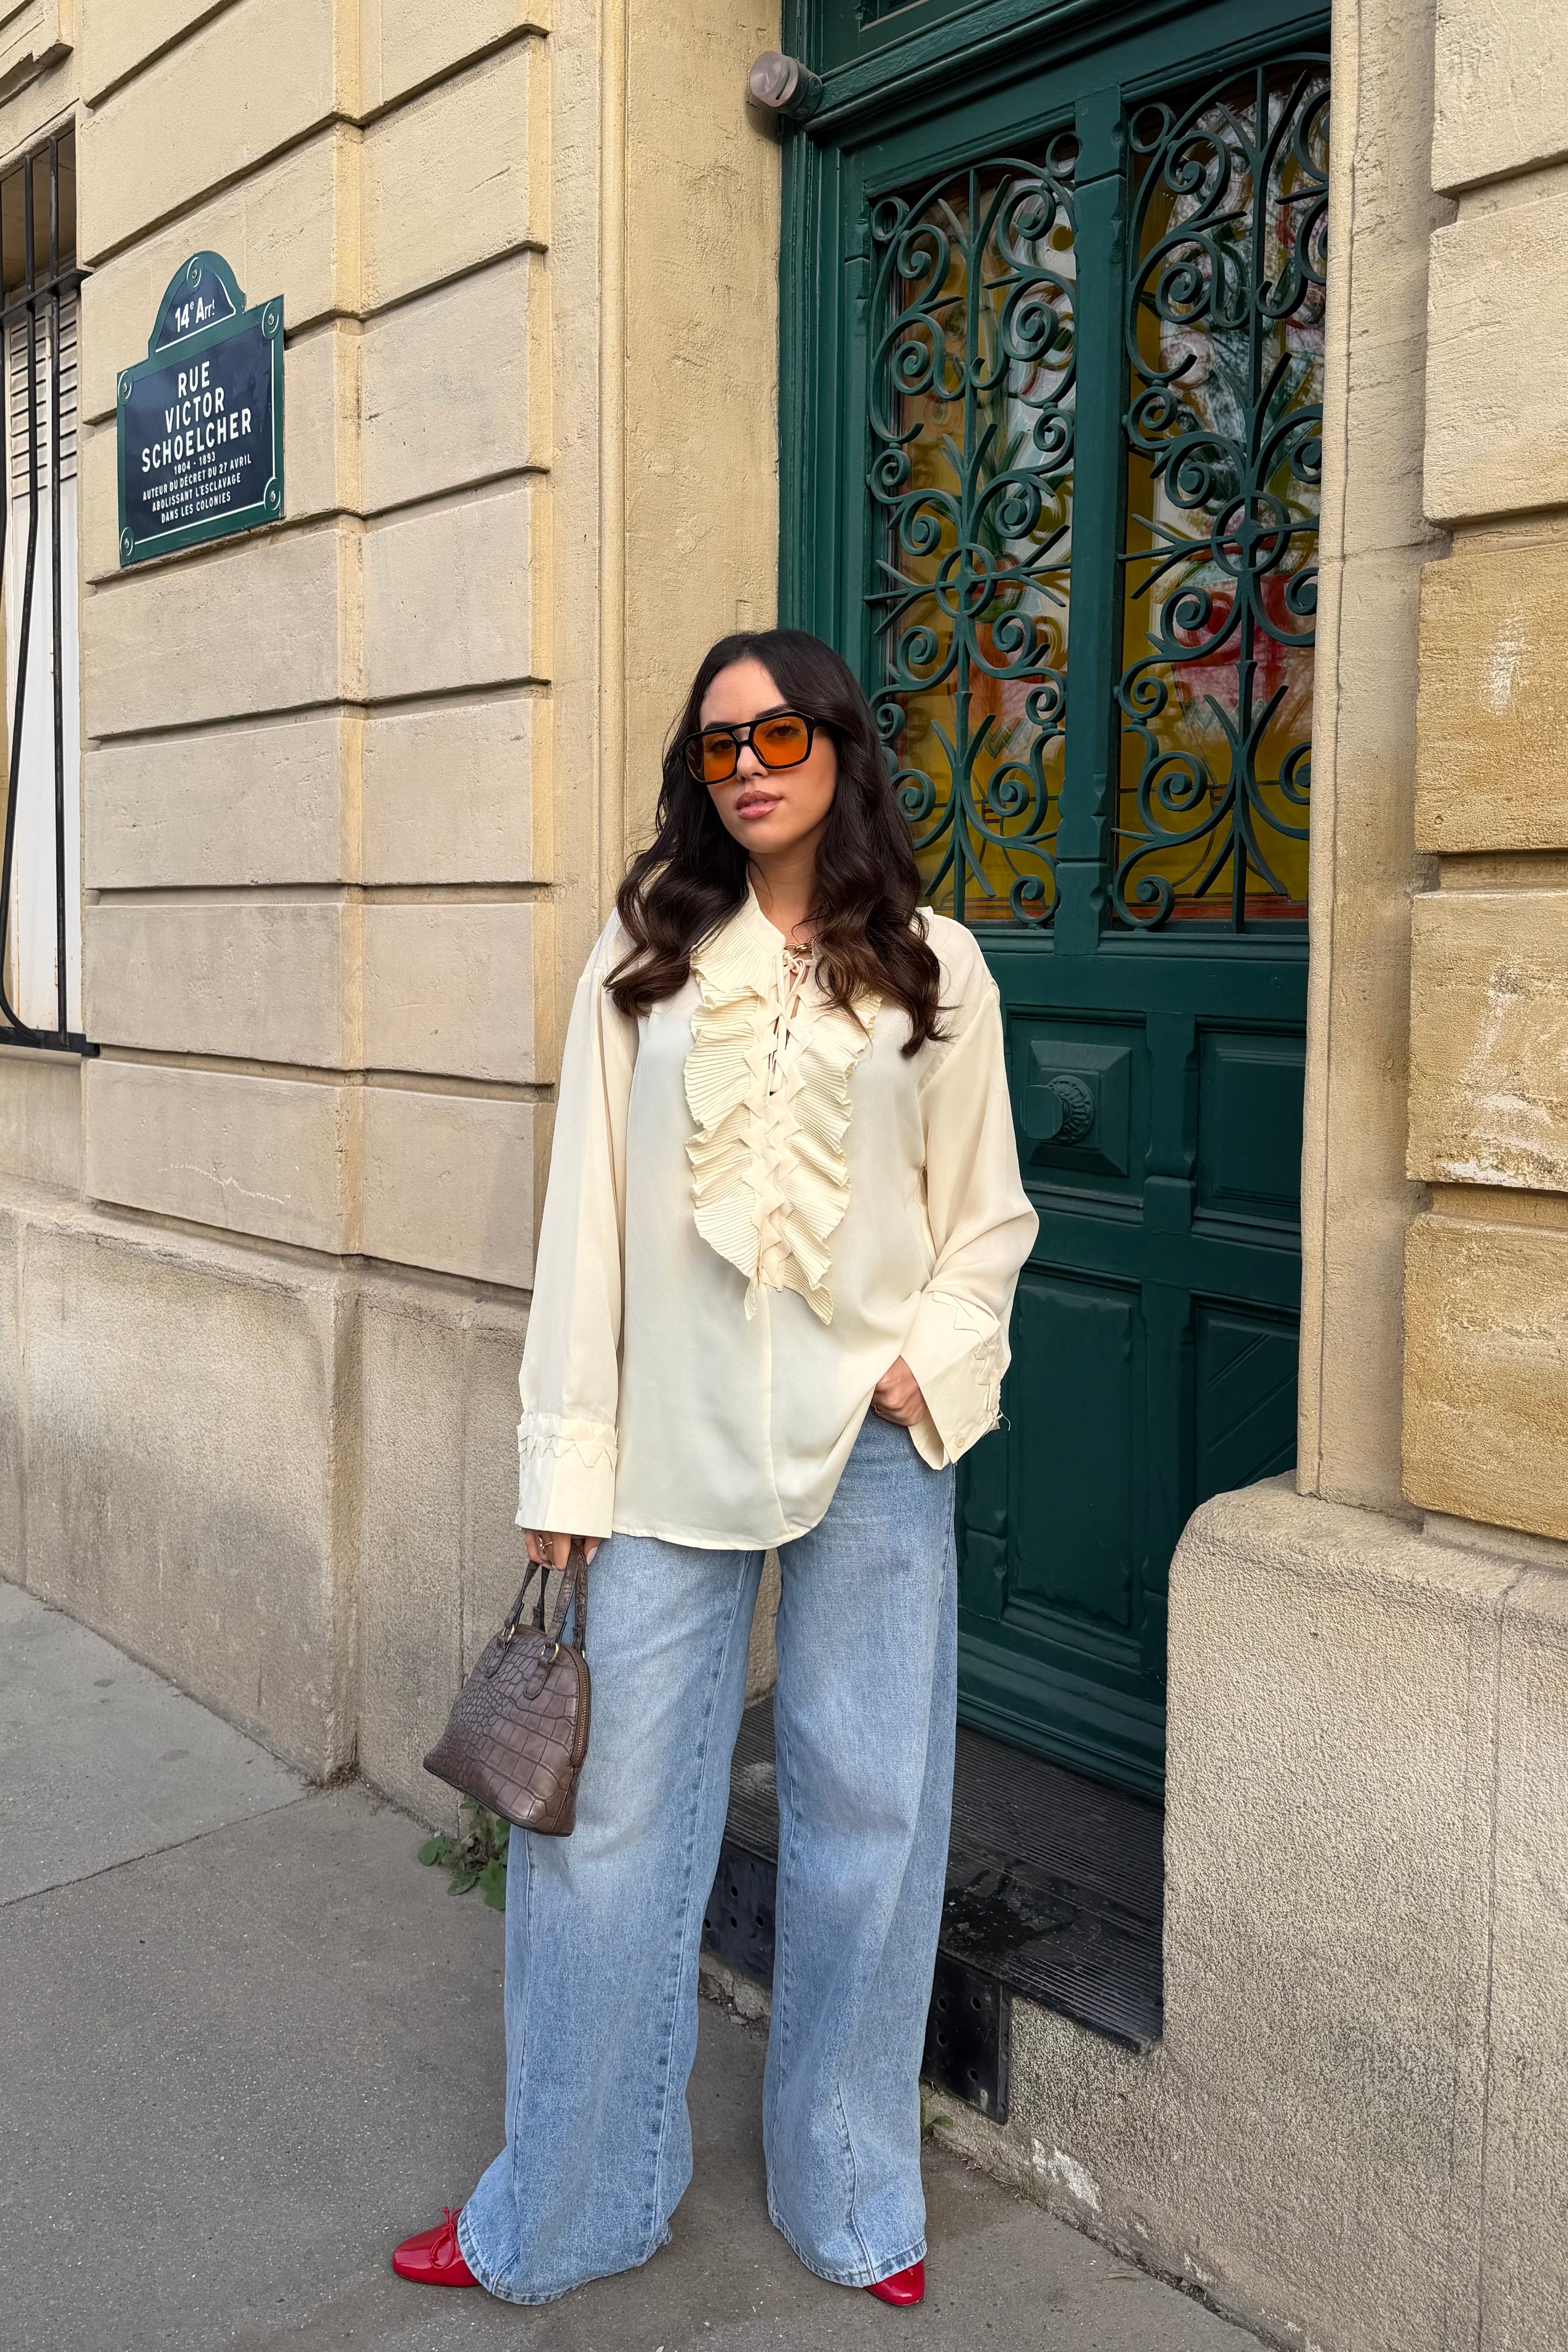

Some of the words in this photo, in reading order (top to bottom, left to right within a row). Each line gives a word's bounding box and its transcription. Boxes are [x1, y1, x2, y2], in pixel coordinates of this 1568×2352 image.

[178, 361, 210, 398] RUE
[165, 387, 225, 434] VICTOR
[142, 408, 251, 473] SCHOELCHER
[142, 483, 168, 501] AUTEUR
[169, 480, 178, 492] DU
[180, 469, 206, 489] DÉCRET
[208, 466, 217, 478] DU
[219, 462, 227, 474] 27
[230, 454, 252, 470] AVRIL
[174, 460, 191, 475] 1804
[199, 451, 216, 466] 1893
[152, 489, 193, 512] ABOLISSANT
[195, 473, 241, 498] L'ESCLAVAGE
[161, 508, 179, 524] DANS
[181, 504, 194, 517] LES
[196, 491, 231, 512] COLONIES
